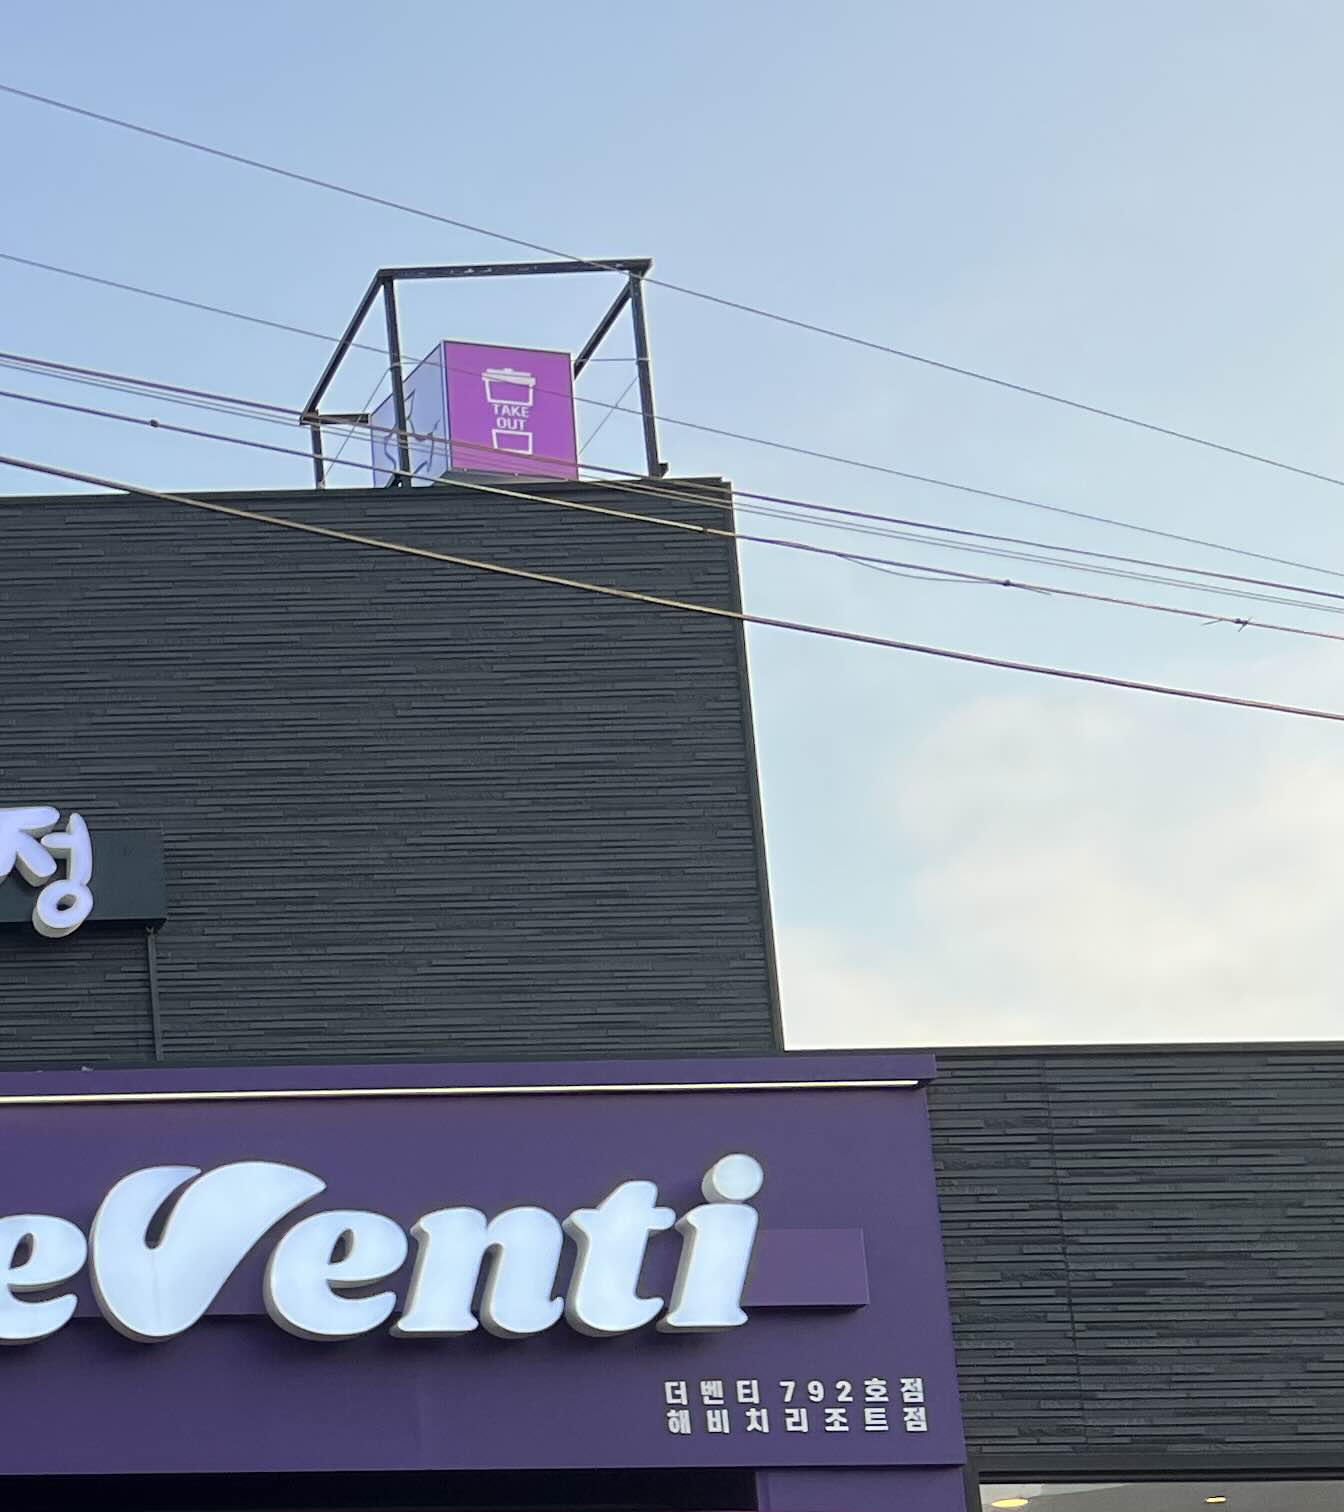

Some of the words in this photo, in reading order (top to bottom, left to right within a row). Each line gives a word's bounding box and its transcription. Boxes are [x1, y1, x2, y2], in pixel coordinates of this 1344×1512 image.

[493, 404, 529, 418] TAKE
[496, 417, 527, 431] OUT
[664, 1379, 760, 1406] 더벤티
[779, 1377, 925, 1403] 792호점
[666, 1406, 928, 1434] 해비치리조트점
